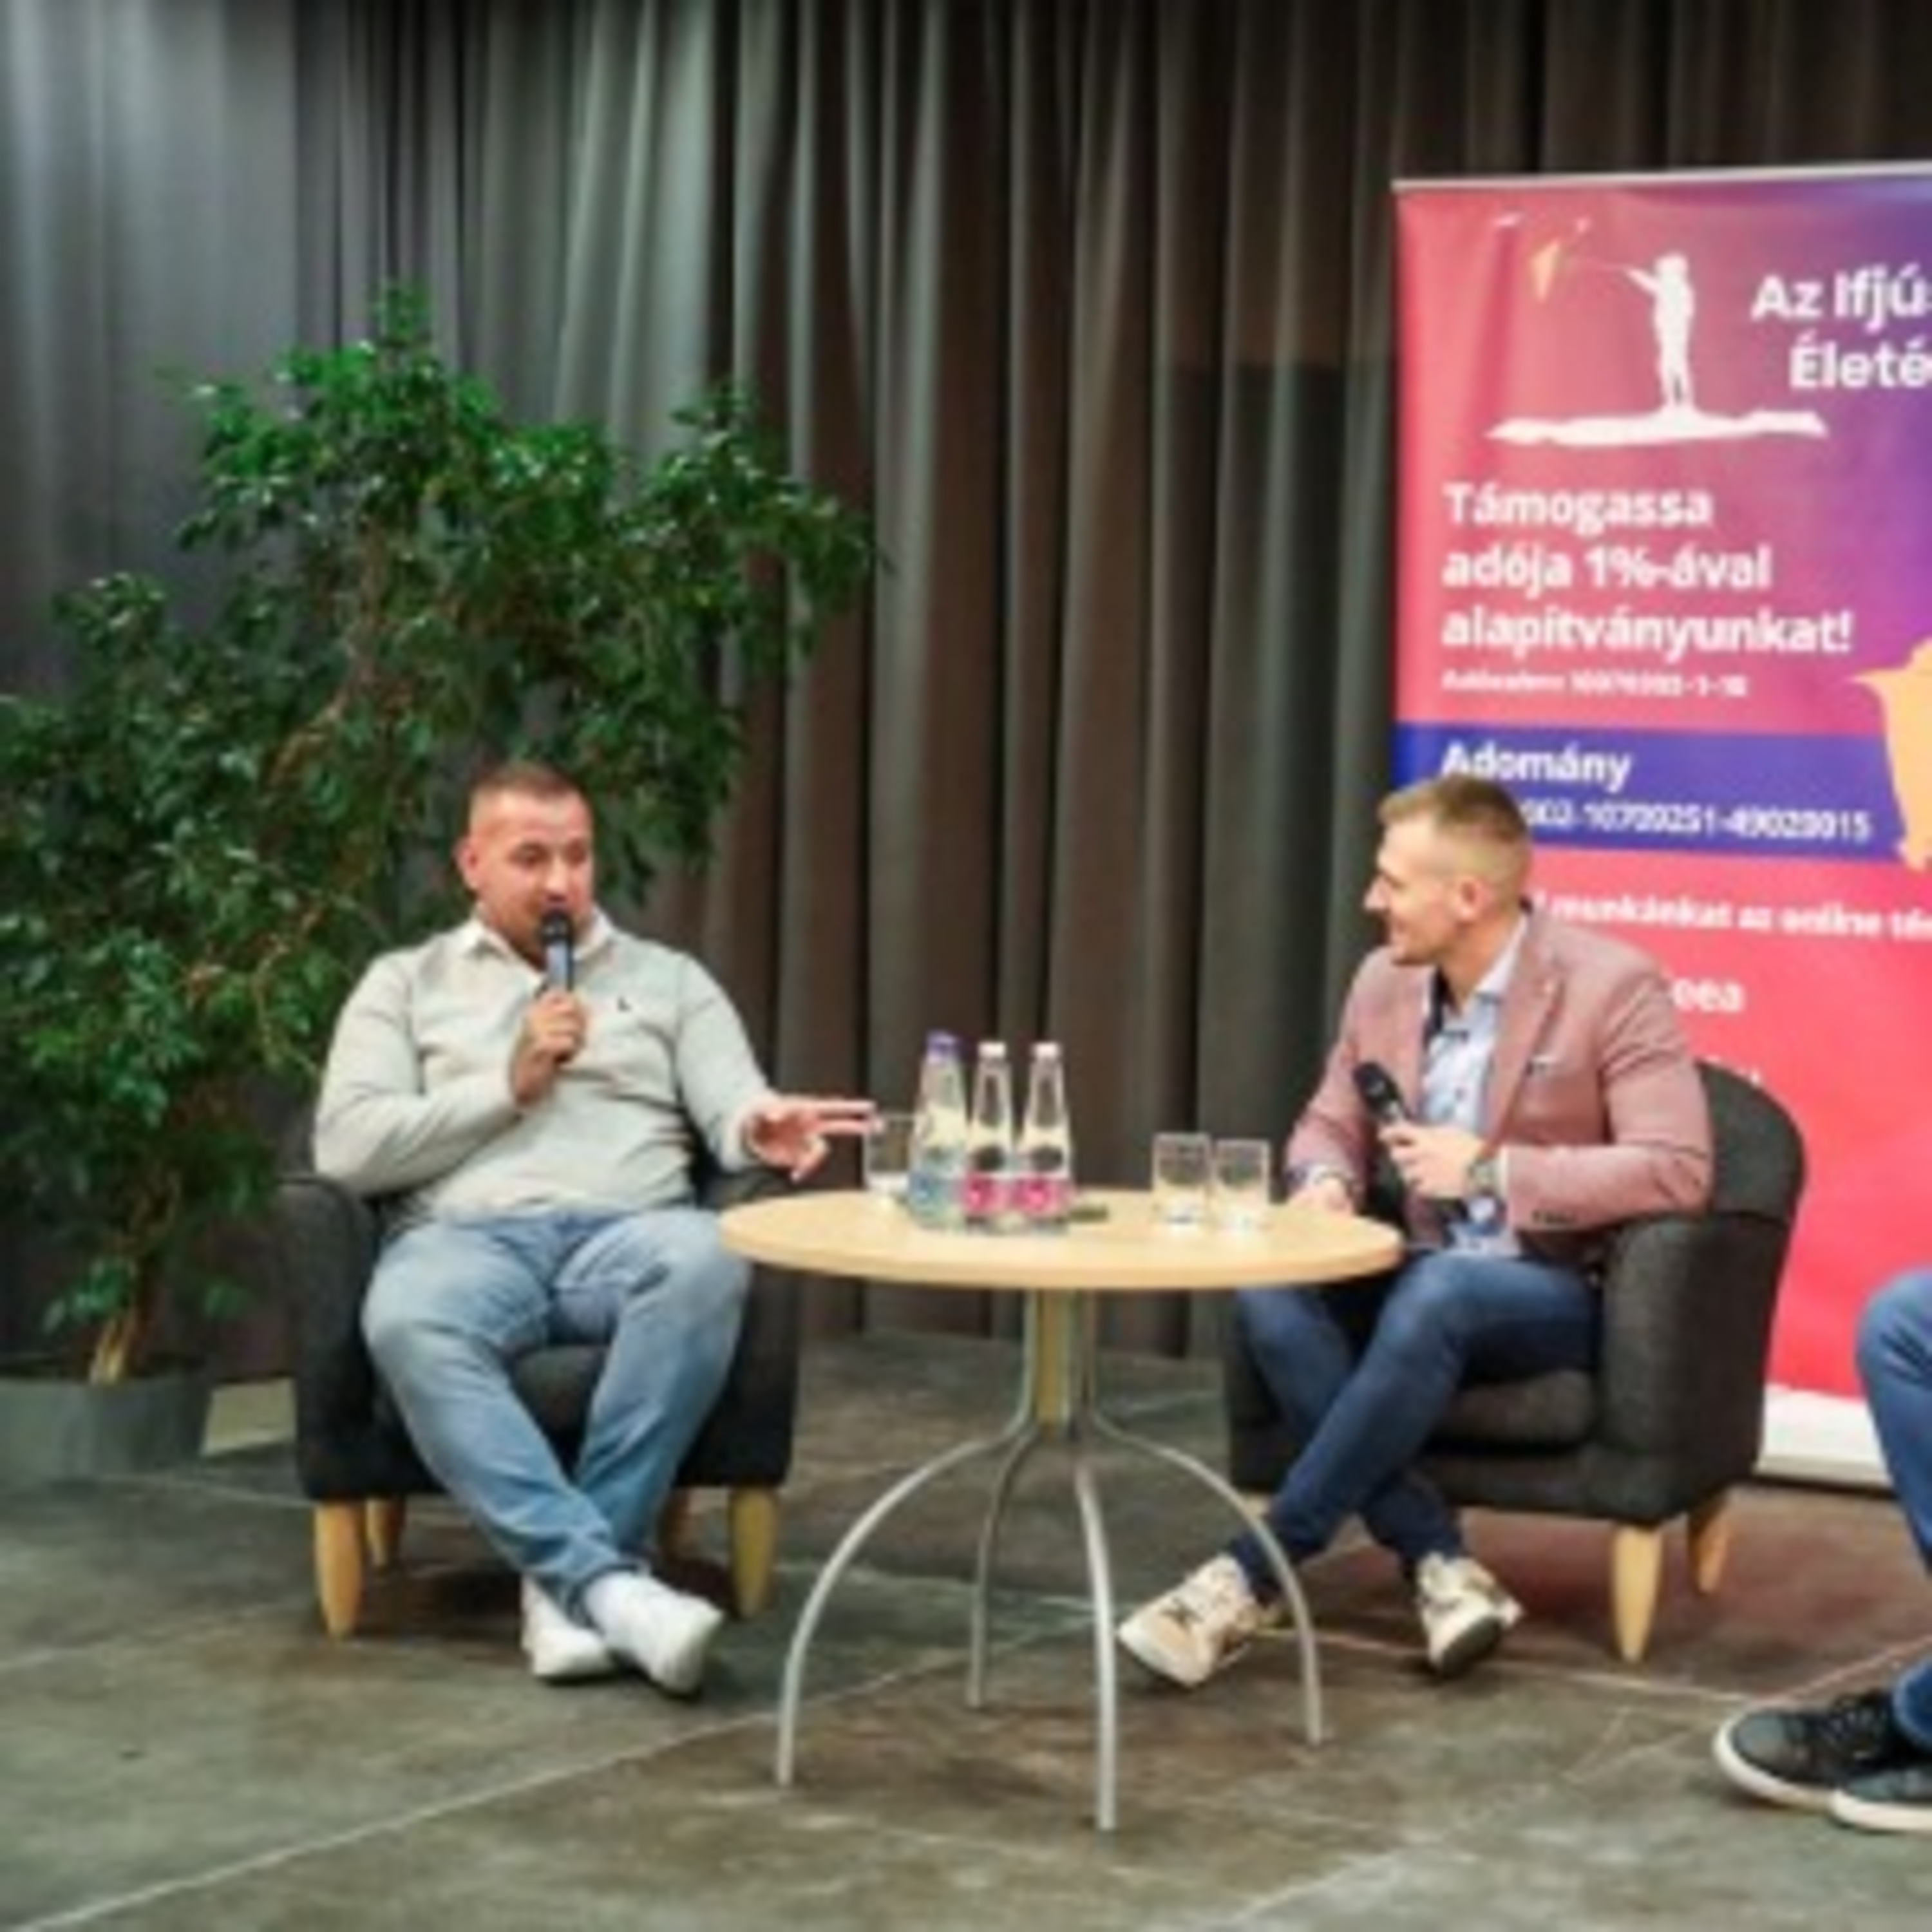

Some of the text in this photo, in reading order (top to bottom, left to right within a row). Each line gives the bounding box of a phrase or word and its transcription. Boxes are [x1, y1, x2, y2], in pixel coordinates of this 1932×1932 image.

[1750, 260, 1932, 335] Az Ifjú
[1789, 327, 1932, 389] Életé
[1442, 480, 1714, 537] Támogassa
[1442, 538, 1774, 600] adója 1%-ával
[1442, 604, 1853, 663] alapítványunkat!
[1441, 739, 1632, 792] Adomány
